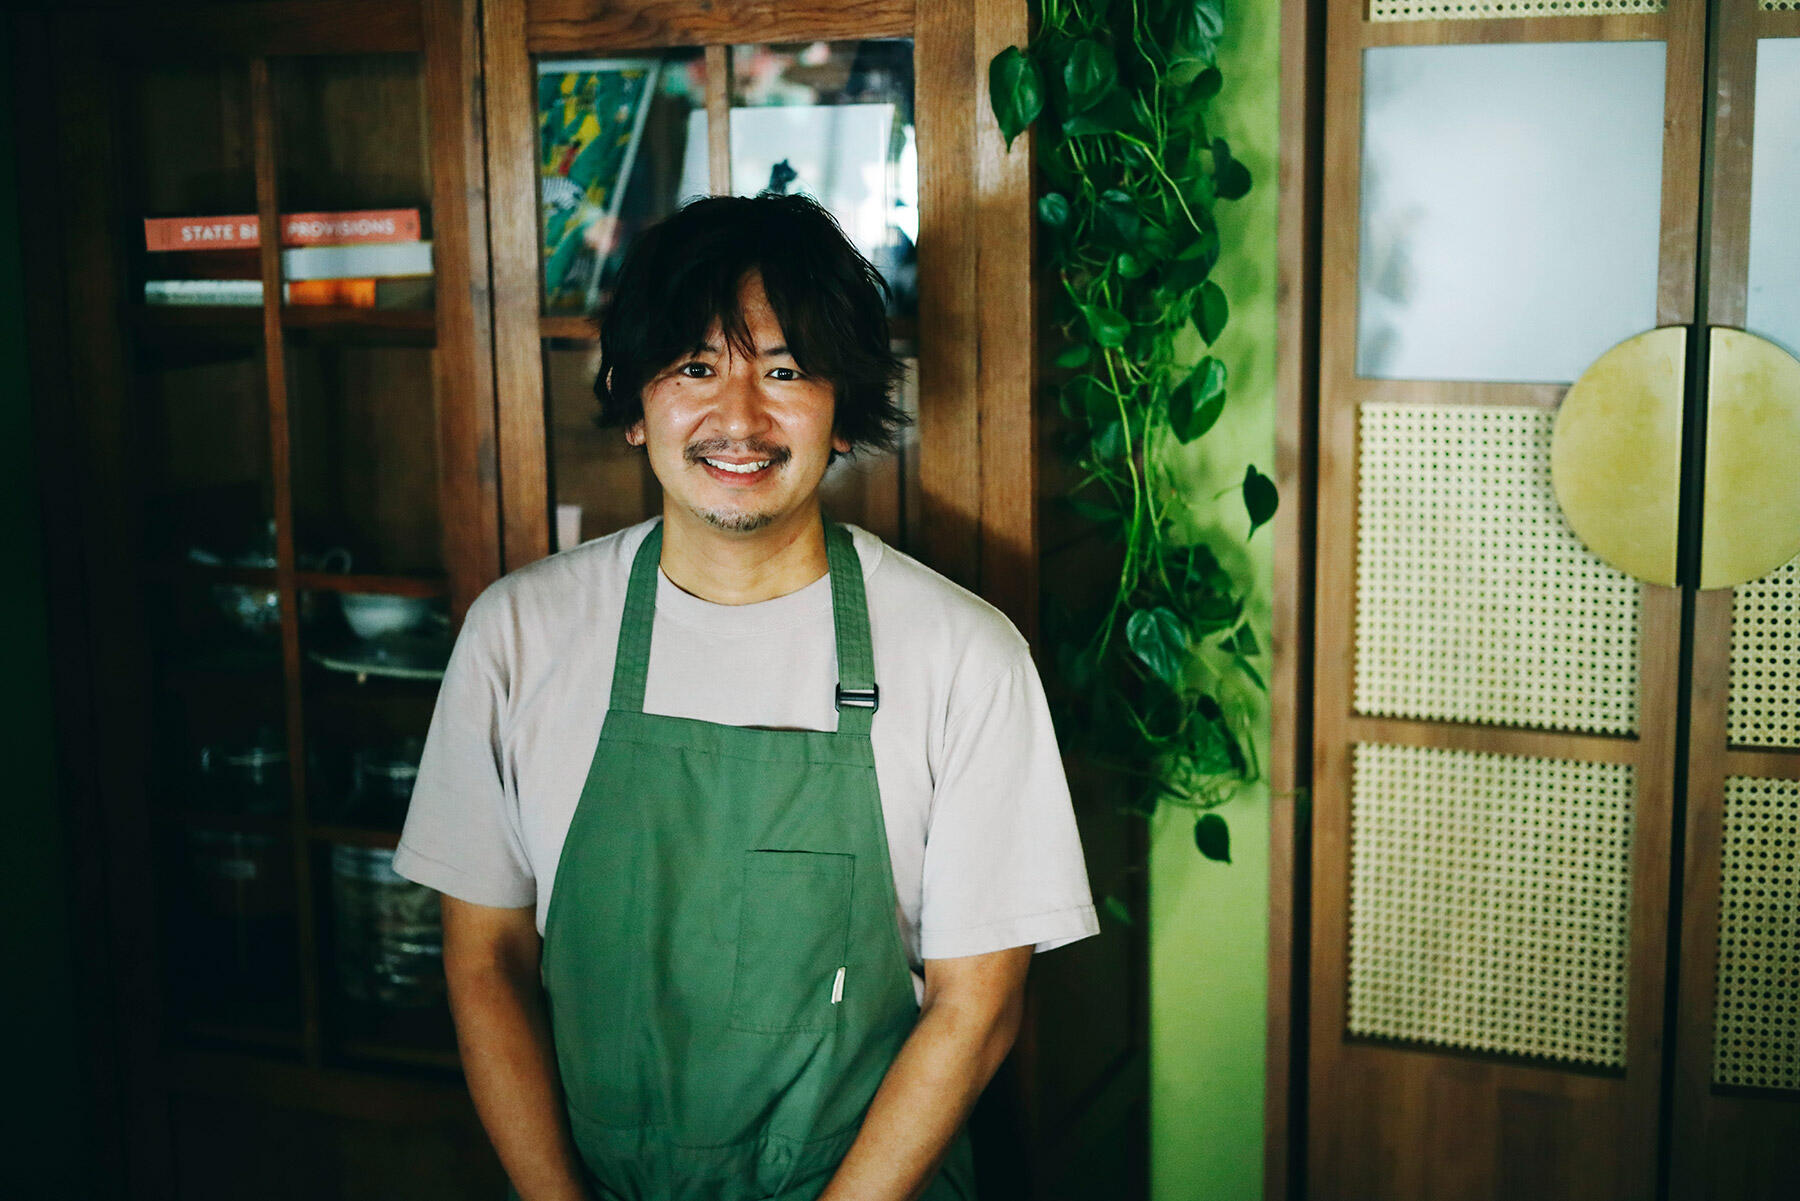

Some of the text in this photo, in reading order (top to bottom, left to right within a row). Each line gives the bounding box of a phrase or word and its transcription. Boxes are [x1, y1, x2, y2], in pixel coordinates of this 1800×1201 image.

[182, 224, 234, 242] STATE
[239, 224, 258, 240] BI
[287, 218, 396, 237] PROVISIONS
